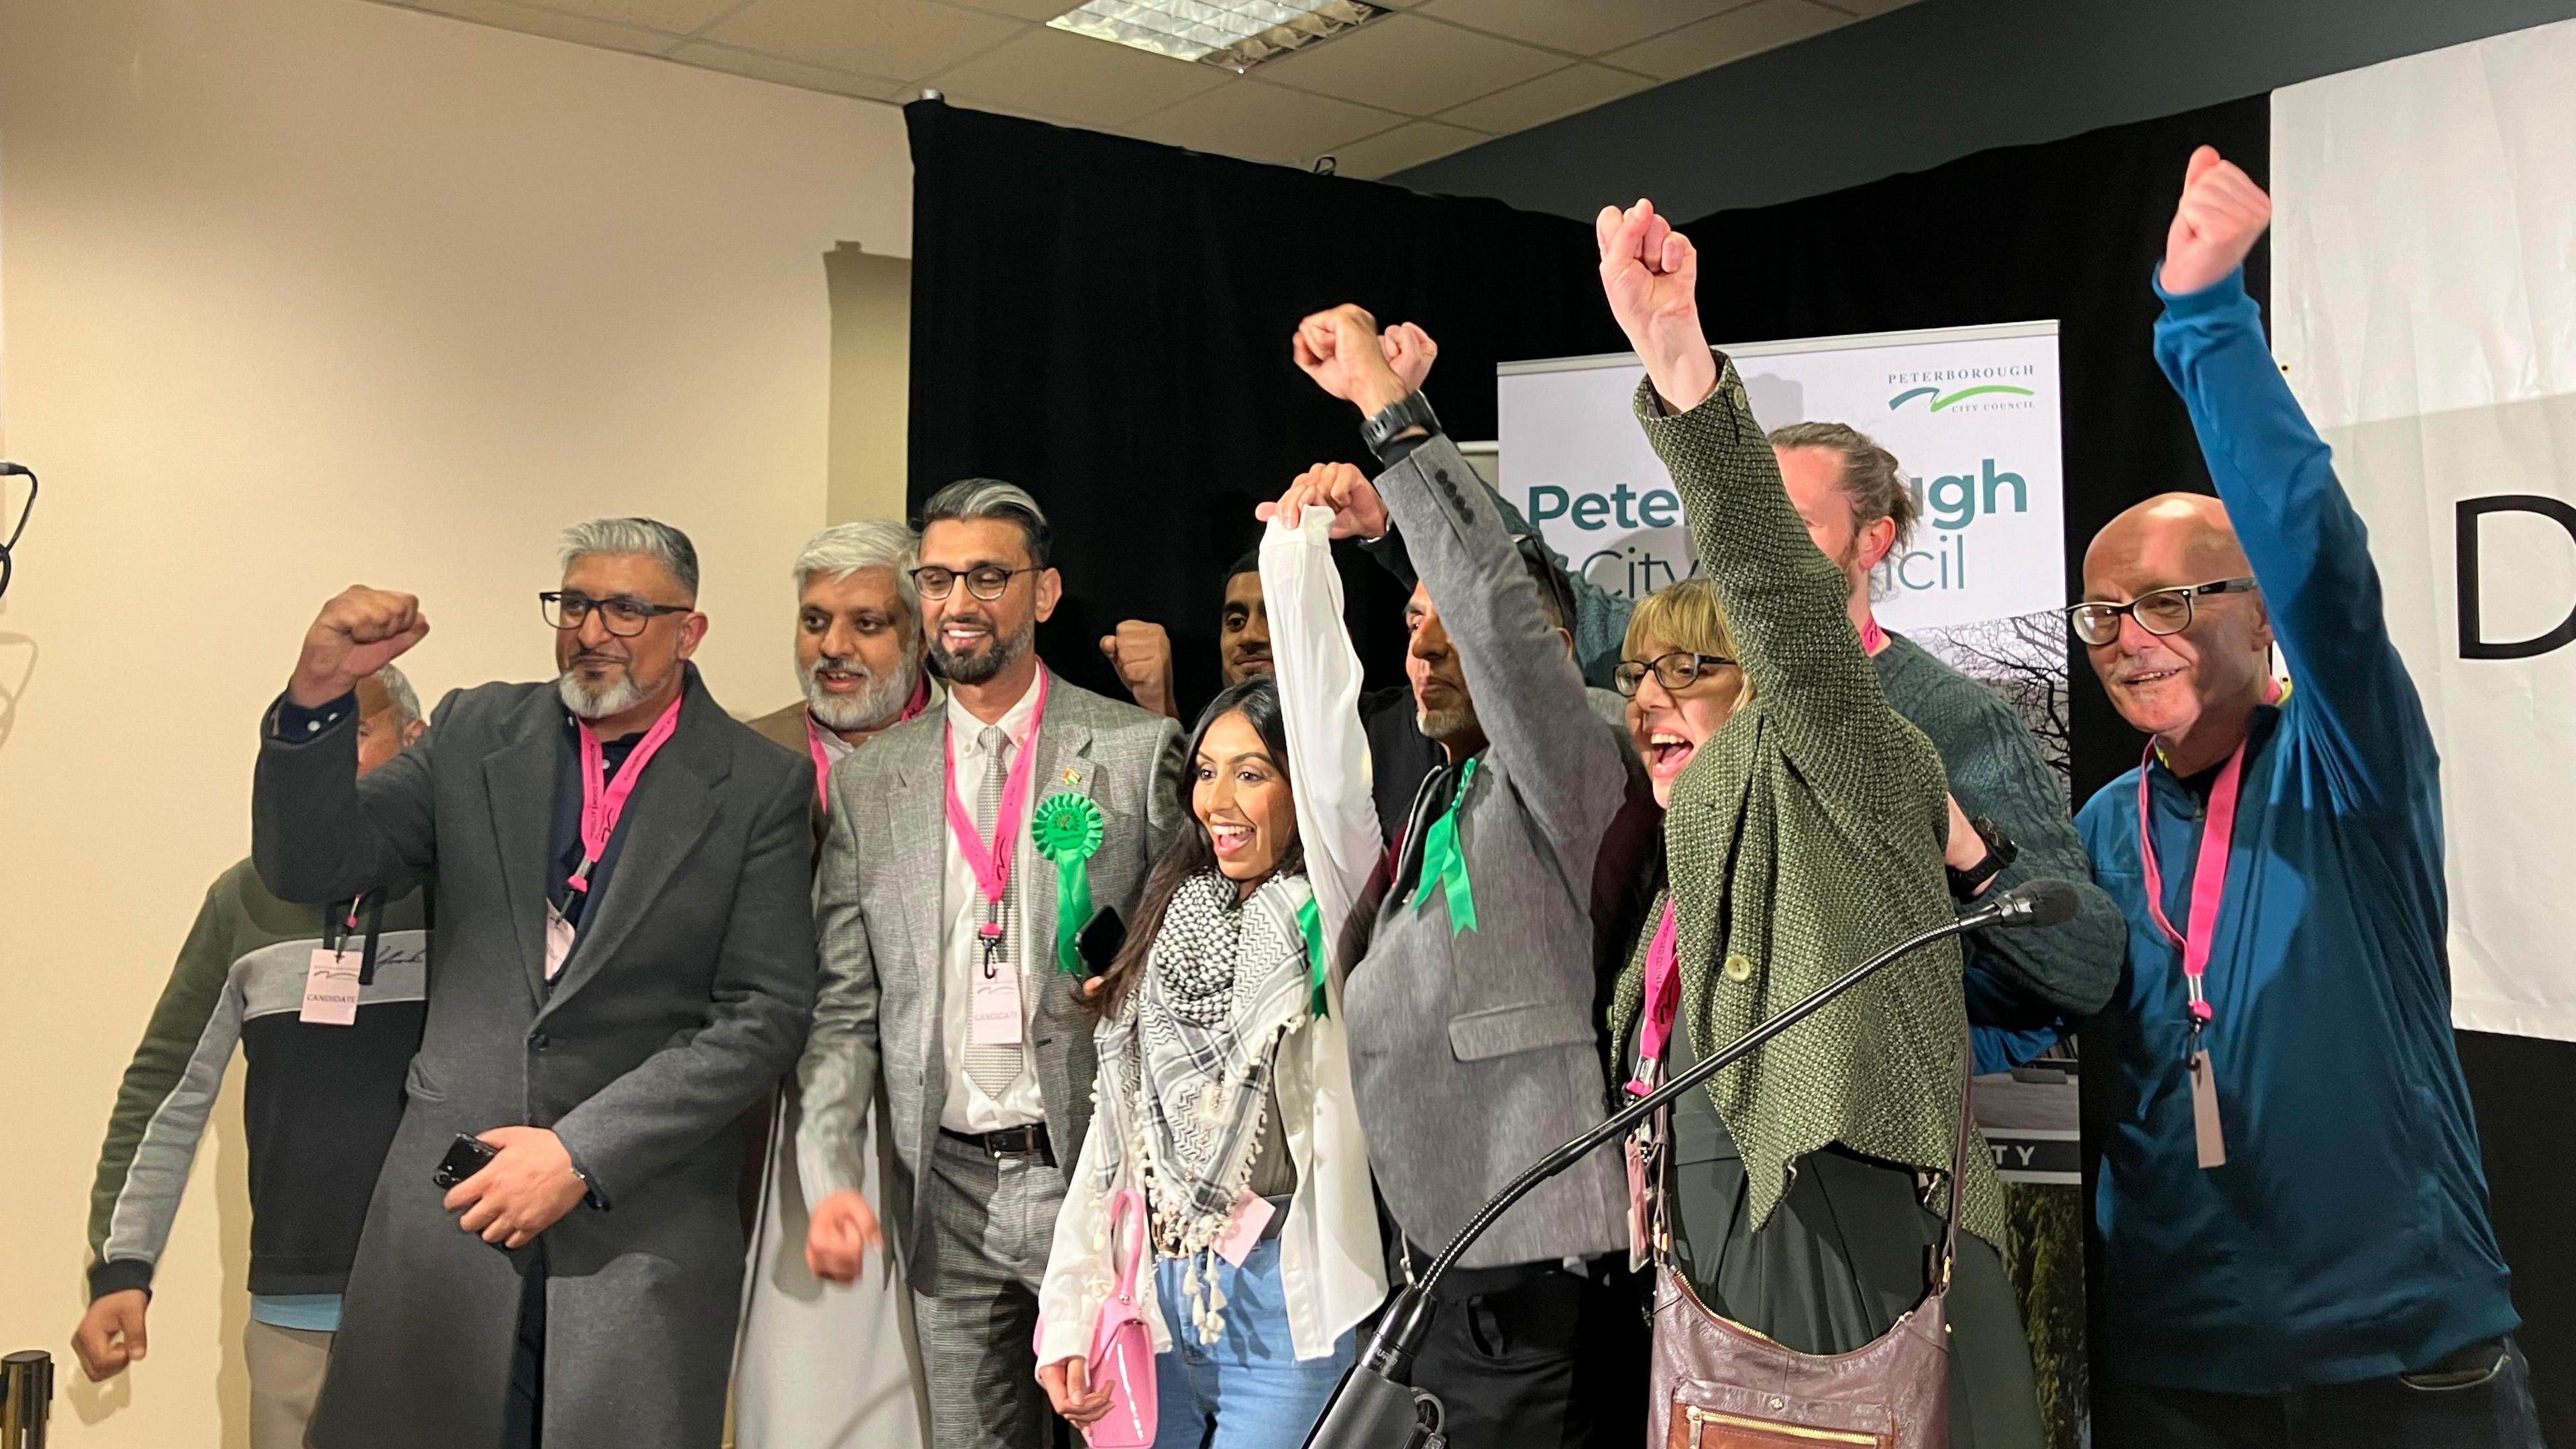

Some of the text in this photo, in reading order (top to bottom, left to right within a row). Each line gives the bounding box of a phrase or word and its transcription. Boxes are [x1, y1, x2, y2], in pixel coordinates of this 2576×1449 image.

[1888, 365, 2033, 384] PETERBOROUGH
[1951, 401, 2035, 413] CITY COUNCIL
[2456, 494, 2576, 660] D
